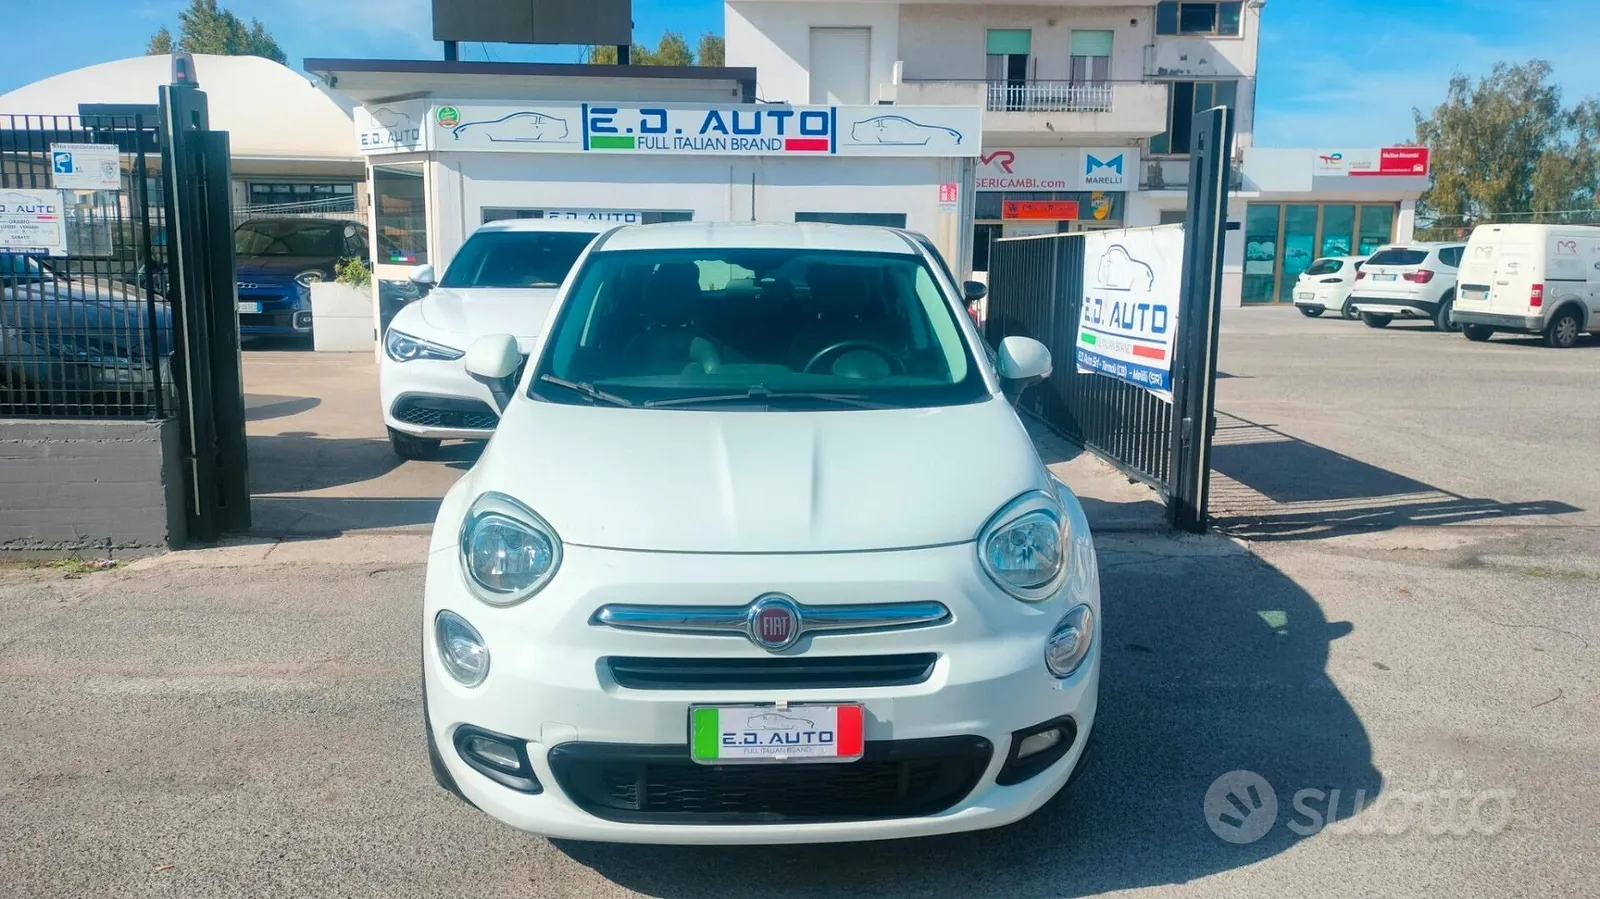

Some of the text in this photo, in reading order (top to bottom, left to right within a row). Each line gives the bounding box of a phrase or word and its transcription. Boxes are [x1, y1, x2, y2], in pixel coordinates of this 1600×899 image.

[590, 107, 829, 136] E.D. AUTO
[361, 128, 420, 146] E.D. AUTO
[638, 136, 782, 151] FULL ITALIAN BRAND
[1085, 176, 1123, 184] MARELLI
[16, 205, 56, 213] AUTO
[1109, 301, 1168, 334] AUTO
[763, 616, 789, 636] FIAT
[722, 731, 834, 745] E.D. AUTO
